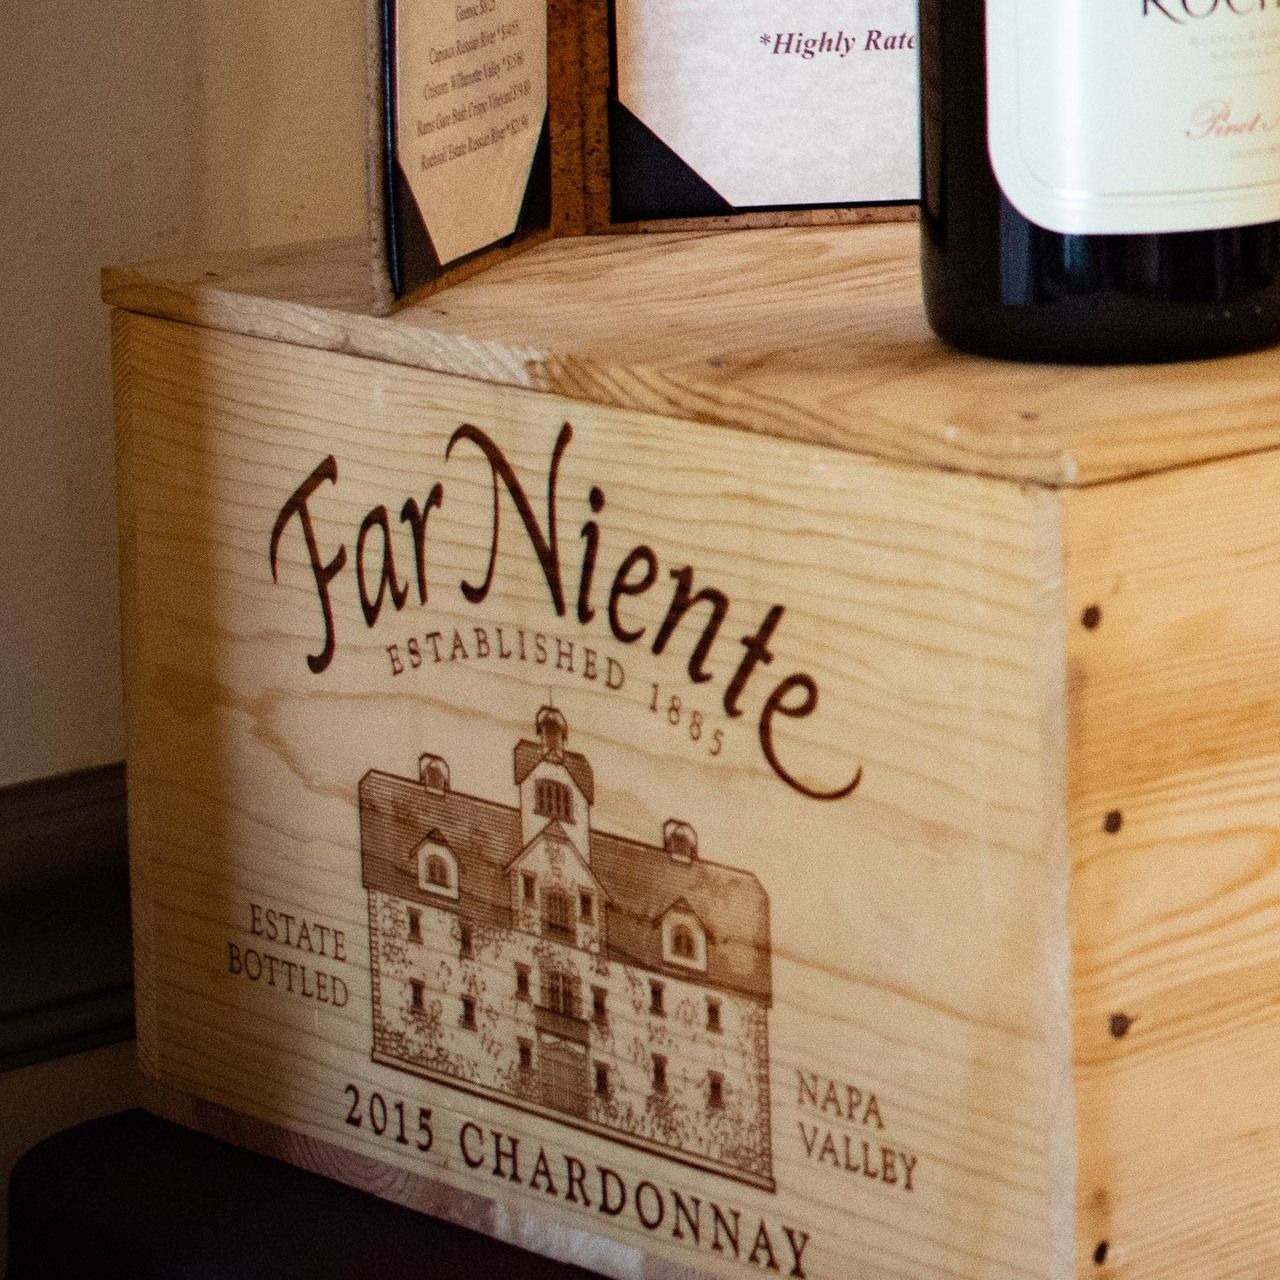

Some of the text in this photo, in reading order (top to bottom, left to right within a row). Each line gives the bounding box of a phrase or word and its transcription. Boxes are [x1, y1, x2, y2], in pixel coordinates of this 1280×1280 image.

[270, 422, 863, 801] Far Niente
[386, 626, 727, 757] ESTABLISHED 1885
[248, 902, 347, 961] ESTATE
[227, 941, 349, 1010] BOTTLED
[796, 1068, 887, 1130] NAPA
[343, 1084, 812, 1280] 2015 CHARDONNAY
[798, 1119, 919, 1192] VALLEY
